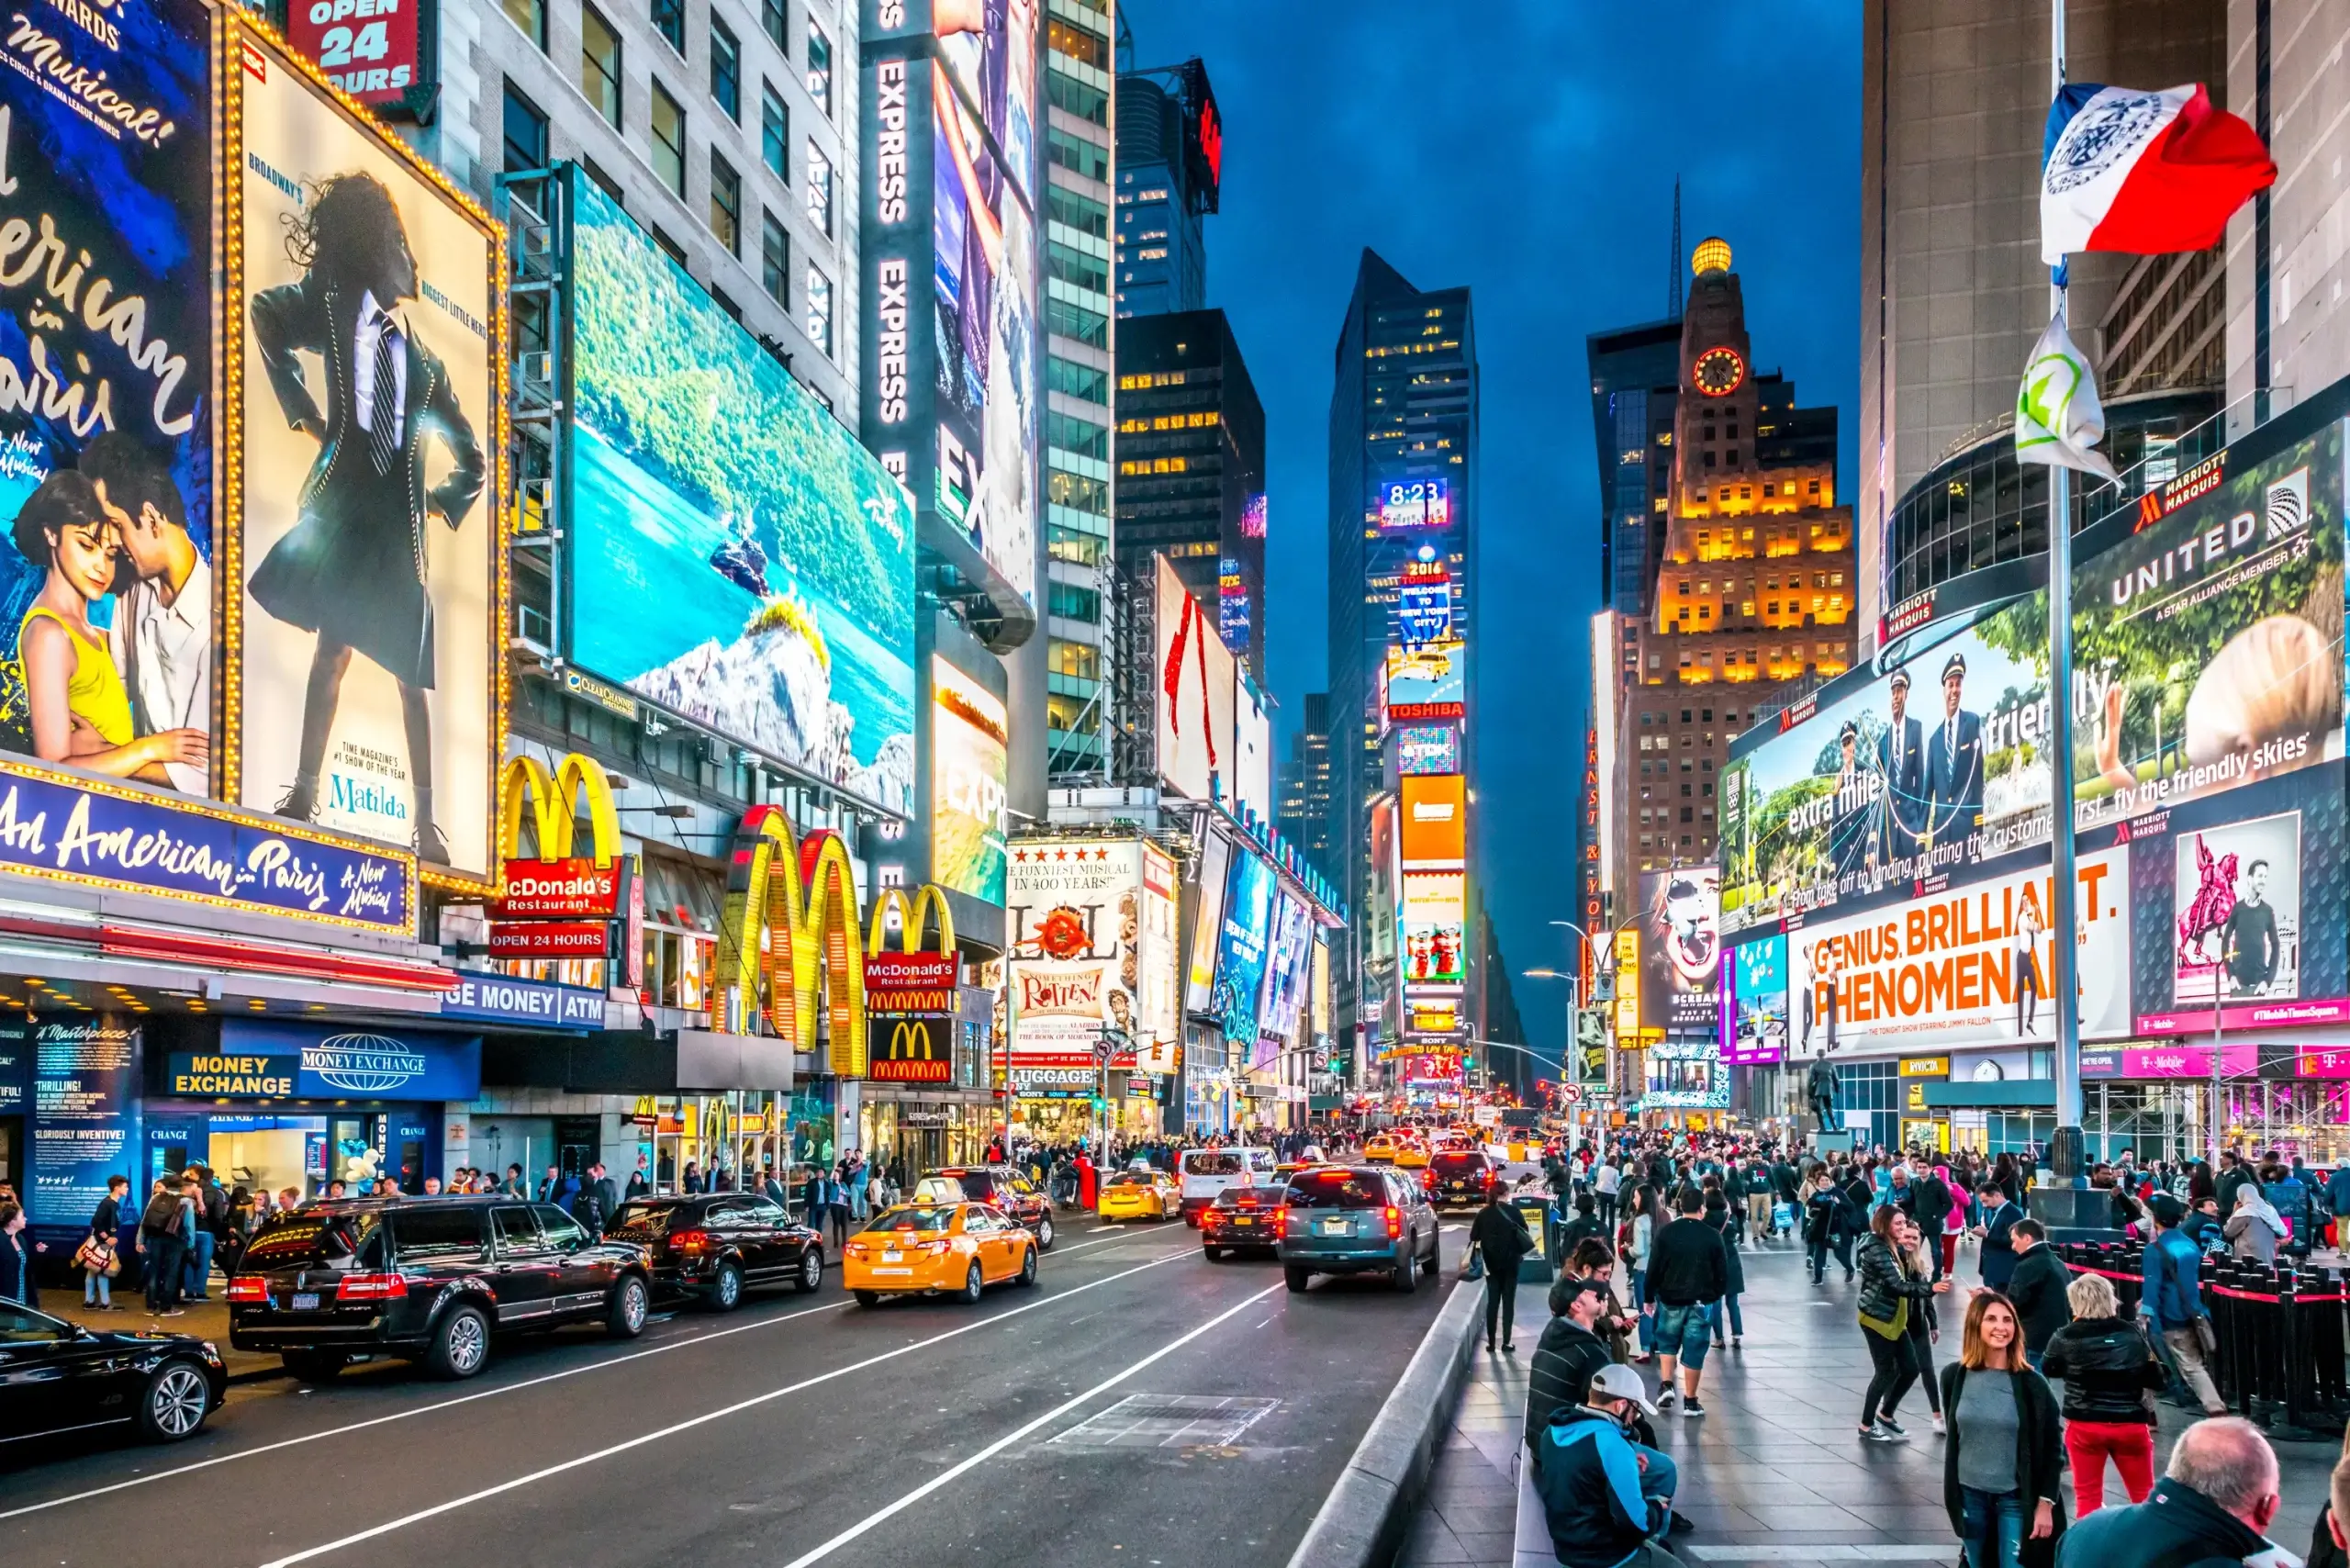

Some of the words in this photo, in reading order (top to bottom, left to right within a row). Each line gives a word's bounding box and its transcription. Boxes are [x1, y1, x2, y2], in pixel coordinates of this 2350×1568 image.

[309, 0, 398, 24] OPEN
[319, 21, 388, 67] 24
[7, 13, 174, 149] Musical!
[327, 64, 410, 94] OURS
[9, 57, 35, 81] CIRCLE
[37, 74, 42, 86] &
[43, 79, 67, 103] DRAMA
[68, 96, 94, 121] LEAGUE
[94, 115, 120, 140] AWARDS
[879, 60, 906, 224] EXPRESS
[249, 152, 303, 206] BROADWAY'S
[421, 280, 449, 315] BIGGEST
[449, 297, 470, 326] LITTLE
[470, 311, 487, 341] HERO
[0, 213, 193, 436] erican
[879, 258, 907, 425] EXPRESS
[6, 431, 44, 456] New
[2165, 450, 2227, 497] MARRIOTT
[1390, 483, 1438, 506] 8:23
[2165, 470, 2221, 511] MARQUIS
[2112, 510, 2256, 606] UNITED
[1409, 563, 1441, 577] 2016
[1402, 585, 1449, 596] WELCOME
[2155, 609, 2164, 622] A
[2164, 599, 2188, 621] STAR
[2188, 576, 2241, 613] ALLIANCE
[2240, 551, 2289, 582] MEMBER
[1401, 607, 1423, 618] NEW
[1424, 607, 1449, 617] YORK
[1419, 597, 1432, 606] TO
[1889, 588, 1936, 622] MARRIOTT
[1889, 607, 1931, 635] MARQUIS
[1390, 702, 1463, 717] TOSHIBA
[1792, 693, 1818, 715] MARRIOTT
[1792, 705, 1817, 724] MARQUIS
[342, 741, 358, 756] TIME
[360, 746, 398, 767] MAGAZINE'S
[333, 752, 341, 763] #1
[344, 753, 364, 768] SHOW
[366, 761, 375, 771] OF
[376, 764, 388, 776] THE
[390, 767, 406, 780] YEAR
[329, 773, 407, 820] Matilda
[1789, 794, 1834, 834] extra
[1839, 770, 1881, 817] mile
[1792, 890, 1816, 907] From
[1817, 878, 1837, 901] take
[1840, 871, 1855, 895] off
[1857, 869, 1868, 890] to
[1871, 857, 1914, 886] landing,
[1918, 840, 1964, 877] putting
[1967, 831, 1989, 857] the
[1993, 812, 2053, 849] custome
[2074, 795, 2106, 823] irst.
[2114, 783, 2137, 817] fly
[2141, 776, 2170, 804] the
[2173, 748, 2248, 792] friendly
[2253, 732, 2309, 770] skies
[2133, 811, 2170, 827] MARRIOTT
[2133, 822, 2167, 838] MARQUIS
[0, 785, 46, 855] An
[56, 792, 238, 897] American
[235, 867, 257, 884] in
[247, 839, 331, 910] Paris
[341, 864, 353, 890] A
[356, 858, 386, 887] New
[1019, 866, 1074, 876] FUNNIEST
[1080, 864, 1130, 874] MUSICAL
[1925, 873, 1950, 885] MARRIOTT
[504, 876, 612, 896] cDonald's
[1014, 879, 1028, 890] IN
[1033, 879, 1058, 890] 400
[1925, 881, 1947, 893] MARQUIS
[339, 886, 391, 916] Musical
[507, 897, 590, 911] Restaurant
[492, 935, 529, 946] OPEN
[534, 935, 551, 946] 24
[554, 934, 601, 946] HOURS
[867, 964, 953, 976] McDonald's
[482, 985, 554, 1014] MONEY
[565, 997, 602, 1020] ATM
[2254, 1006, 2339, 1021] #TMobileTimesSquare
[1880, 1026, 1901, 1035] TONIGHT
[1902, 1024, 1918, 1032] SHOW
[1919, 1021, 1946, 1031] STARRING
[1948, 1019, 1966, 1028] JIMMY
[1967, 1016, 1991, 1025] FALLON
[192, 1056, 268, 1075] MONEY
[302, 1052, 353, 1070] MONEY
[355, 1055, 426, 1072] EXCHANGE
[175, 1074, 292, 1095] EXCHANGE
[1011, 1070, 1092, 1084] LUGGAGE
[77, 1129, 125, 1140] INVENTIVE!
[151, 1130, 188, 1140] CHANGE
[377, 1114, 386, 1164] MONEY
[400, 1127, 427, 1137] CHANGE
